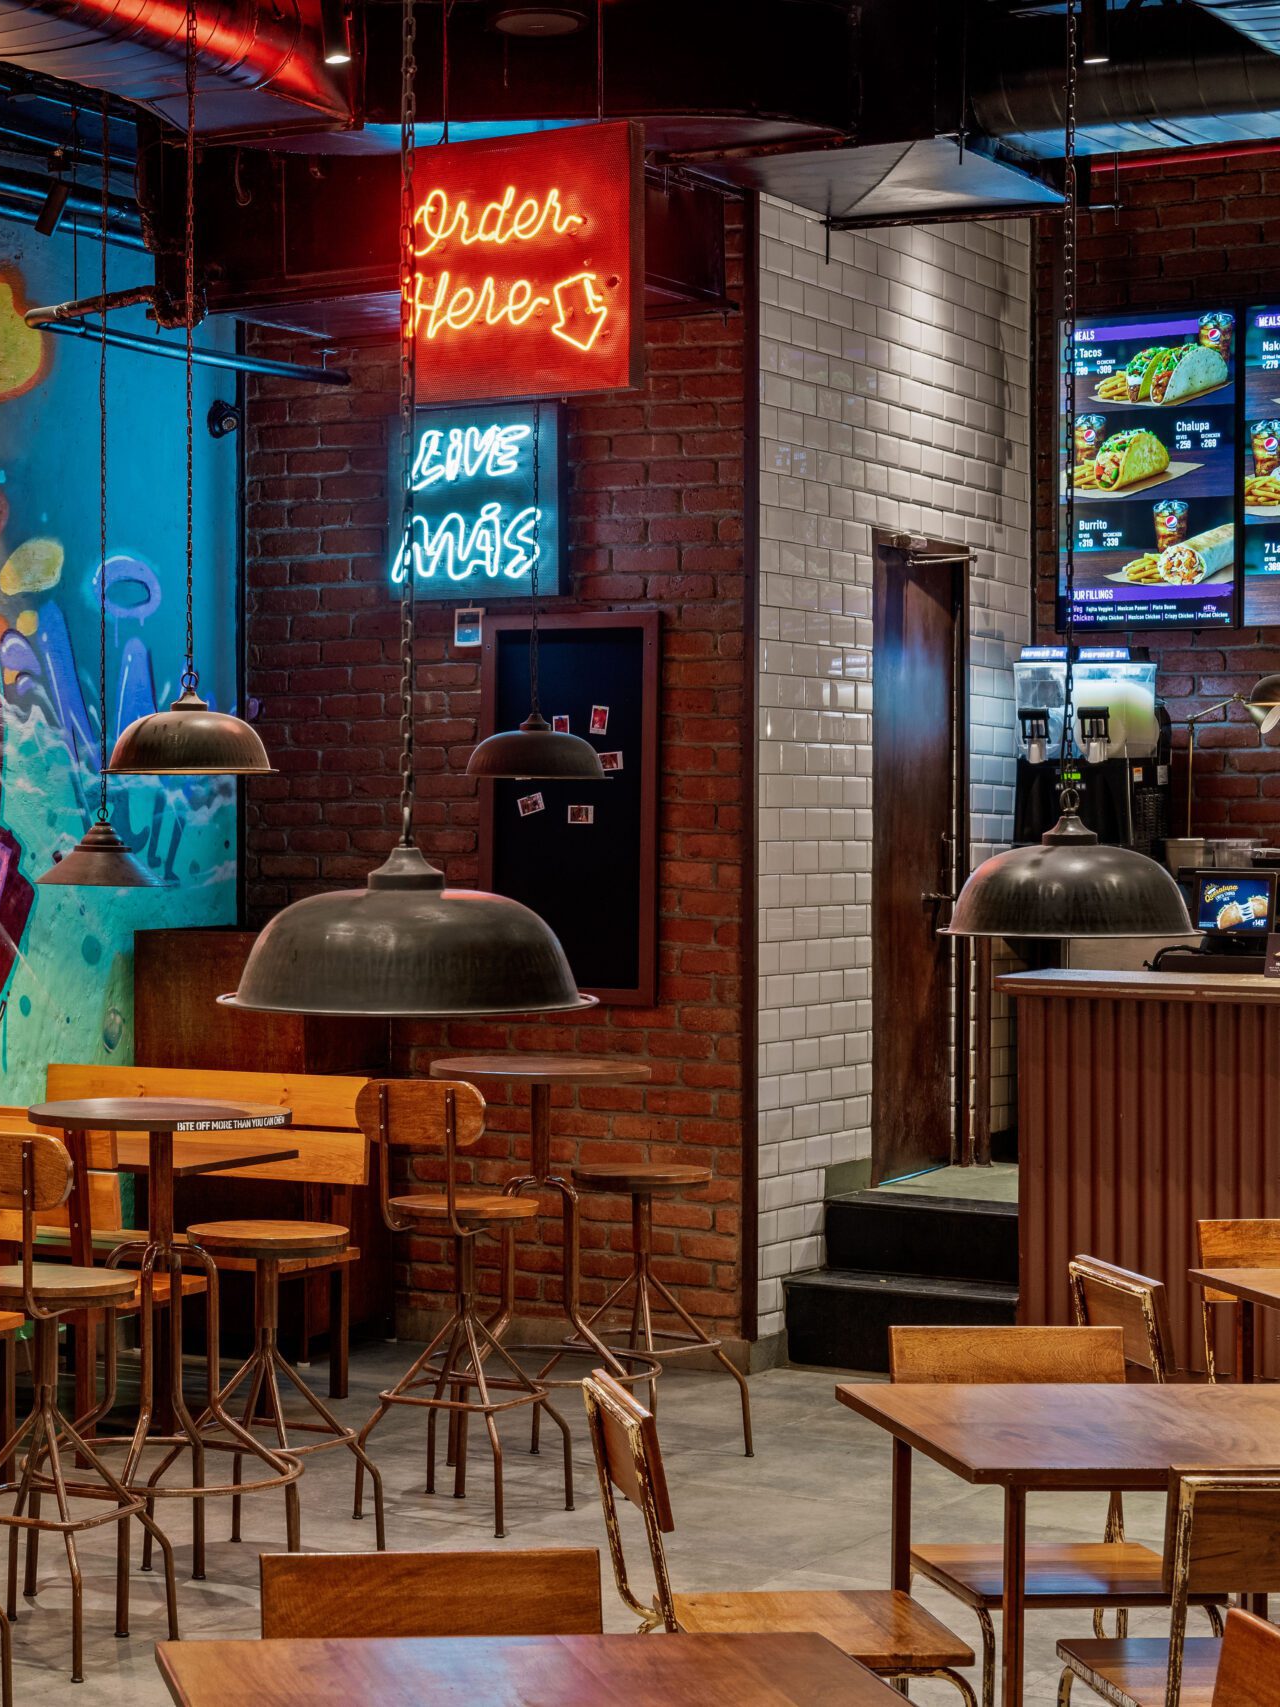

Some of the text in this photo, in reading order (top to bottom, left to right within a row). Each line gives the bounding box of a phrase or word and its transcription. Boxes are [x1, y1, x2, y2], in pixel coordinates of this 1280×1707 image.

[409, 186, 584, 257] Order
[407, 271, 551, 339] Here
[1262, 340, 1280, 351] Nak
[1079, 348, 1102, 358] Tacos
[1176, 420, 1210, 433] Chalupa
[1079, 519, 1108, 530] Burrito
[1086, 589, 1114, 600] FILLINGS
[1073, 605, 1083, 613] Veg
[1073, 614, 1095, 622] Chicken
[195, 1121, 211, 1131] OFF
[211, 1120, 233, 1130] MORE
[233, 1118, 251, 1129] THAN
[252, 1117, 264, 1127] YOU
[263, 1116, 274, 1126] CAN
